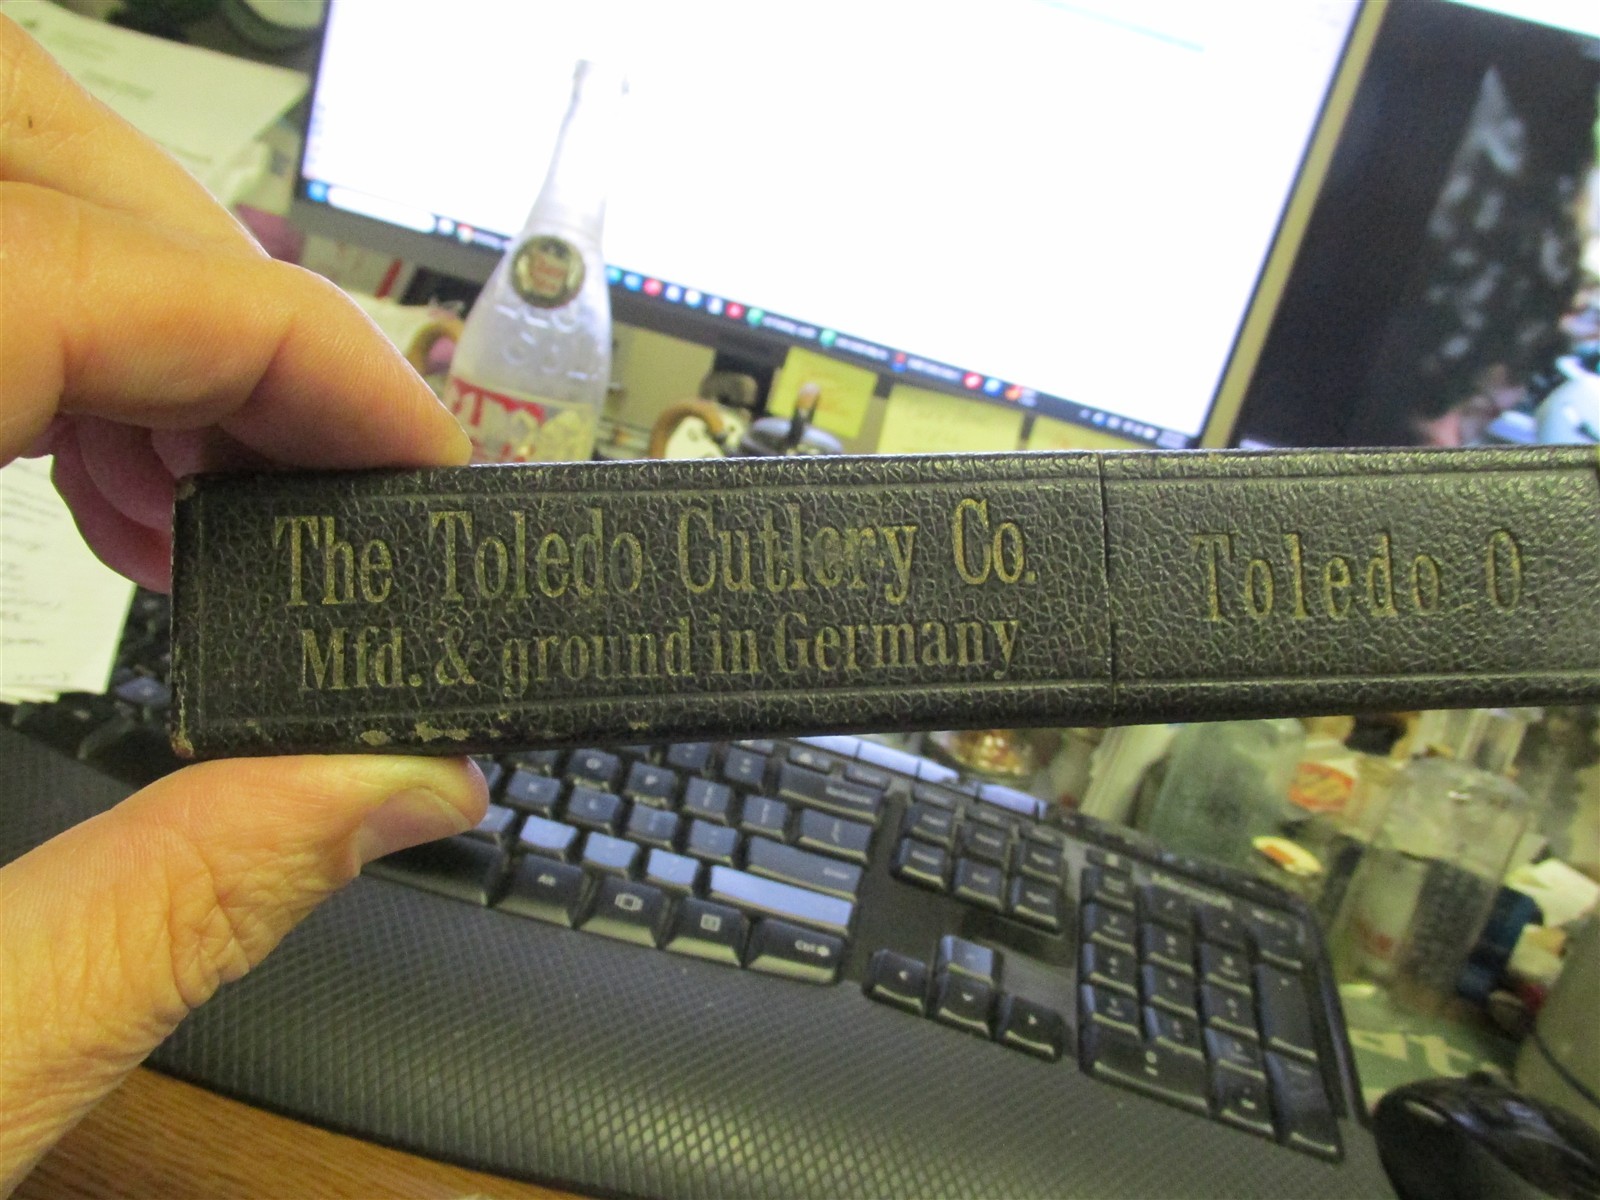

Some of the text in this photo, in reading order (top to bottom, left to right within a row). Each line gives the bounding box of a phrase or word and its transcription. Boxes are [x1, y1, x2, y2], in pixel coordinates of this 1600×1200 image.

[273, 498, 1037, 606] The Toledo Cutlery Co.
[1191, 529, 1524, 623] Toledo O
[300, 612, 1020, 699] Mfd. & ground in Germany
